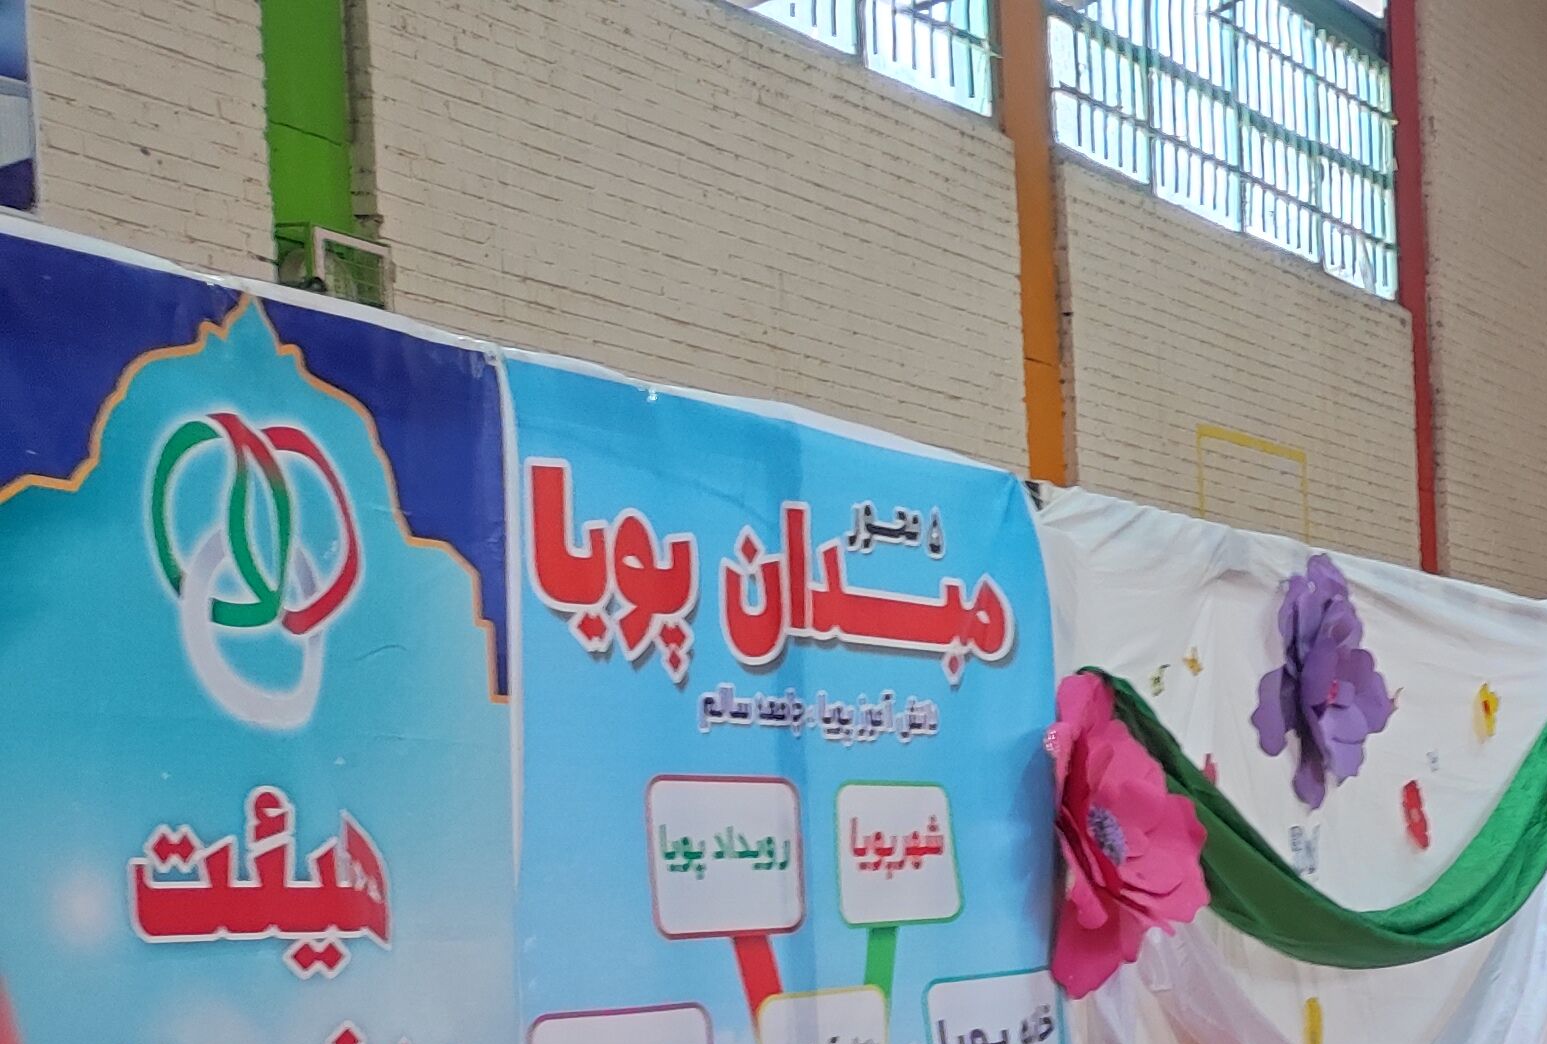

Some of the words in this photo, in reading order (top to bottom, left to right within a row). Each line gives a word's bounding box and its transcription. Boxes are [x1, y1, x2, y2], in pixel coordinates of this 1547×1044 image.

[846, 500, 923, 555] محور
[524, 456, 699, 684] پویا
[699, 683, 752, 733] سالم
[659, 824, 706, 880] پویا
[713, 826, 791, 870] رویداد
[850, 817, 900, 880] پویا
[128, 784, 392, 978] هیئت
